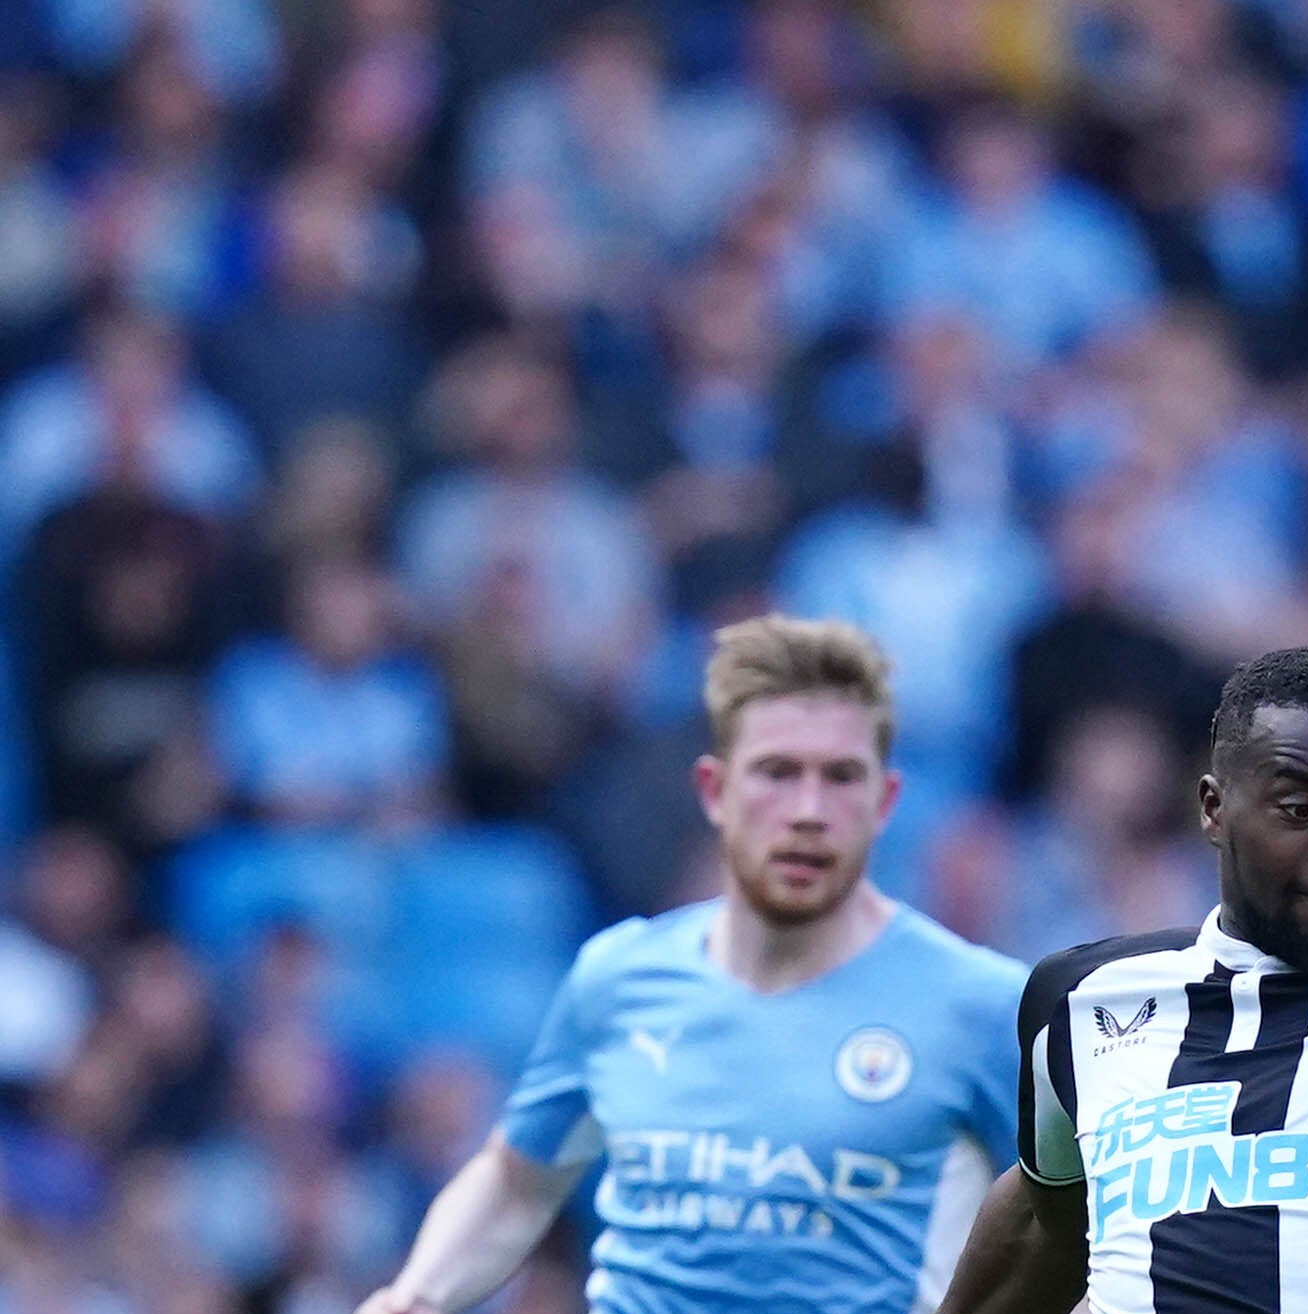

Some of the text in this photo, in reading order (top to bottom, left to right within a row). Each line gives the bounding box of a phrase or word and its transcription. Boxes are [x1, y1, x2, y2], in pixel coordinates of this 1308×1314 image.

[608, 1129, 899, 1199] ETIHAD
[1092, 1085, 1234, 1169] 乐天堂
